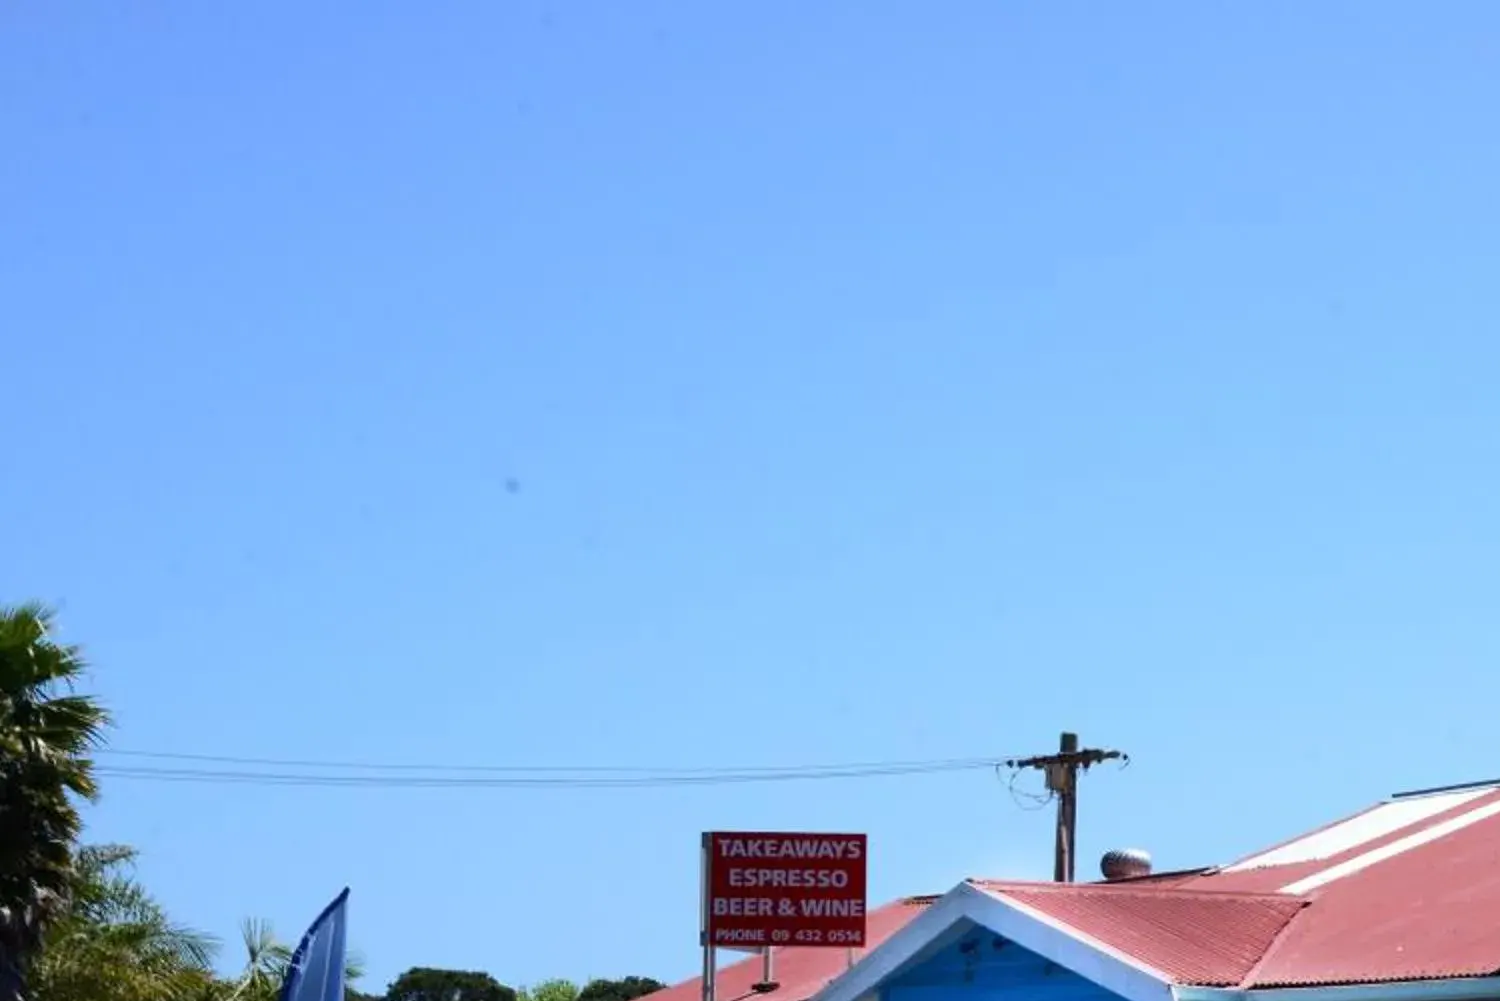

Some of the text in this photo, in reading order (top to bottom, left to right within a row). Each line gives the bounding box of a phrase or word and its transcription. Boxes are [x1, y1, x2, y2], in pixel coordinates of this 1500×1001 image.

[718, 838, 862, 860] TAKEAWAYS
[729, 867, 849, 888] ESPRESSO
[713, 897, 865, 918] BEER & WINE
[715, 929, 862, 943] PHONE 09 432 0514
